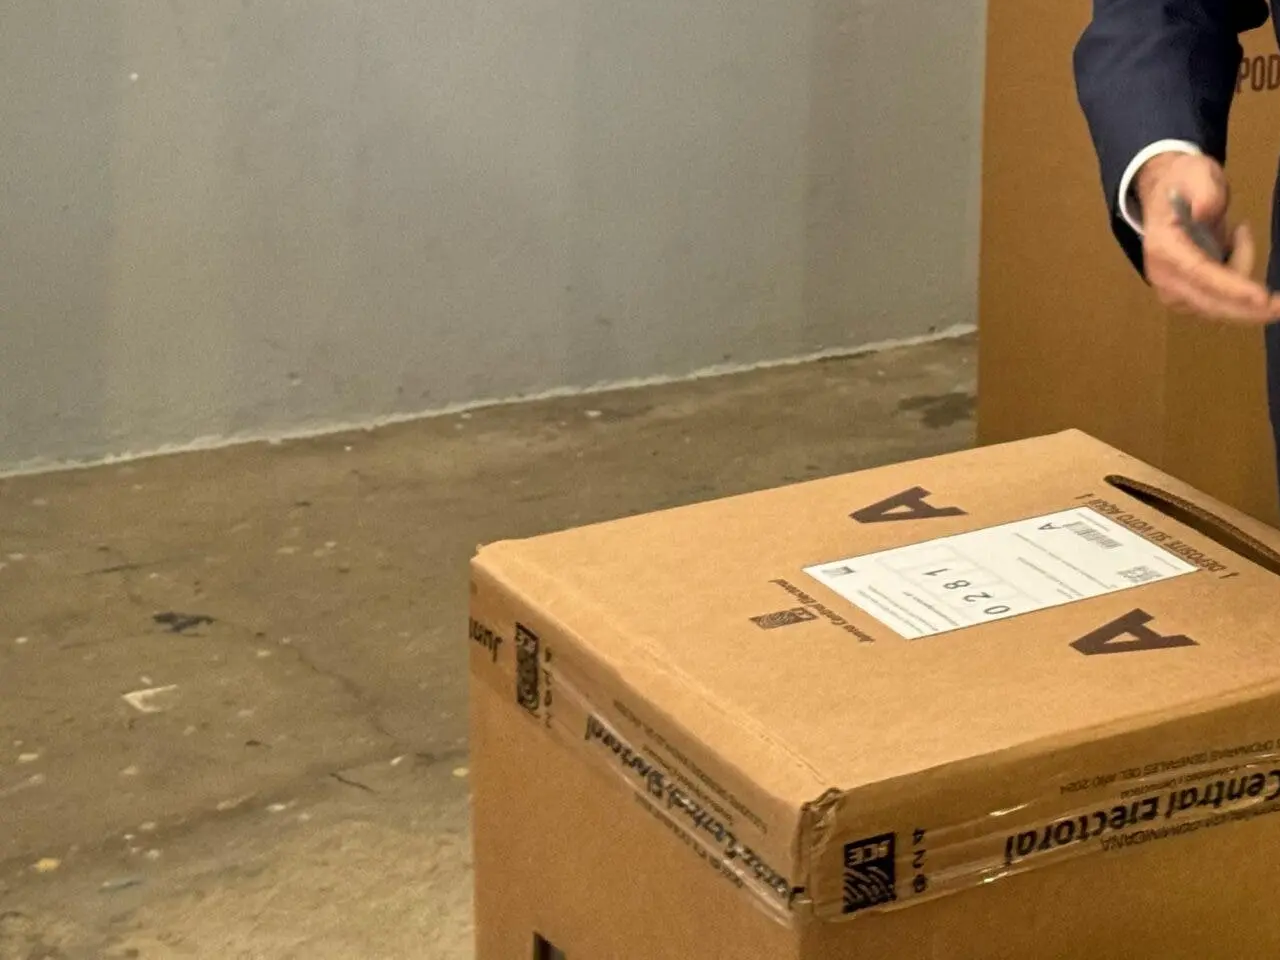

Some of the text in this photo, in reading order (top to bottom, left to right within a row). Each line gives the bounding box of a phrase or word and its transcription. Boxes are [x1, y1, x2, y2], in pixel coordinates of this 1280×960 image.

[850, 485, 968, 524] A
[1037, 522, 1062, 531] A
[1117, 515, 1153, 537] VOTO
[1150, 529, 1173, 545] SU
[1168, 540, 1227, 572] DEPOSITE
[922, 567, 1012, 616] 0281
[1068, 607, 1200, 656] A
[1004, 796, 1160, 867] Electoral
